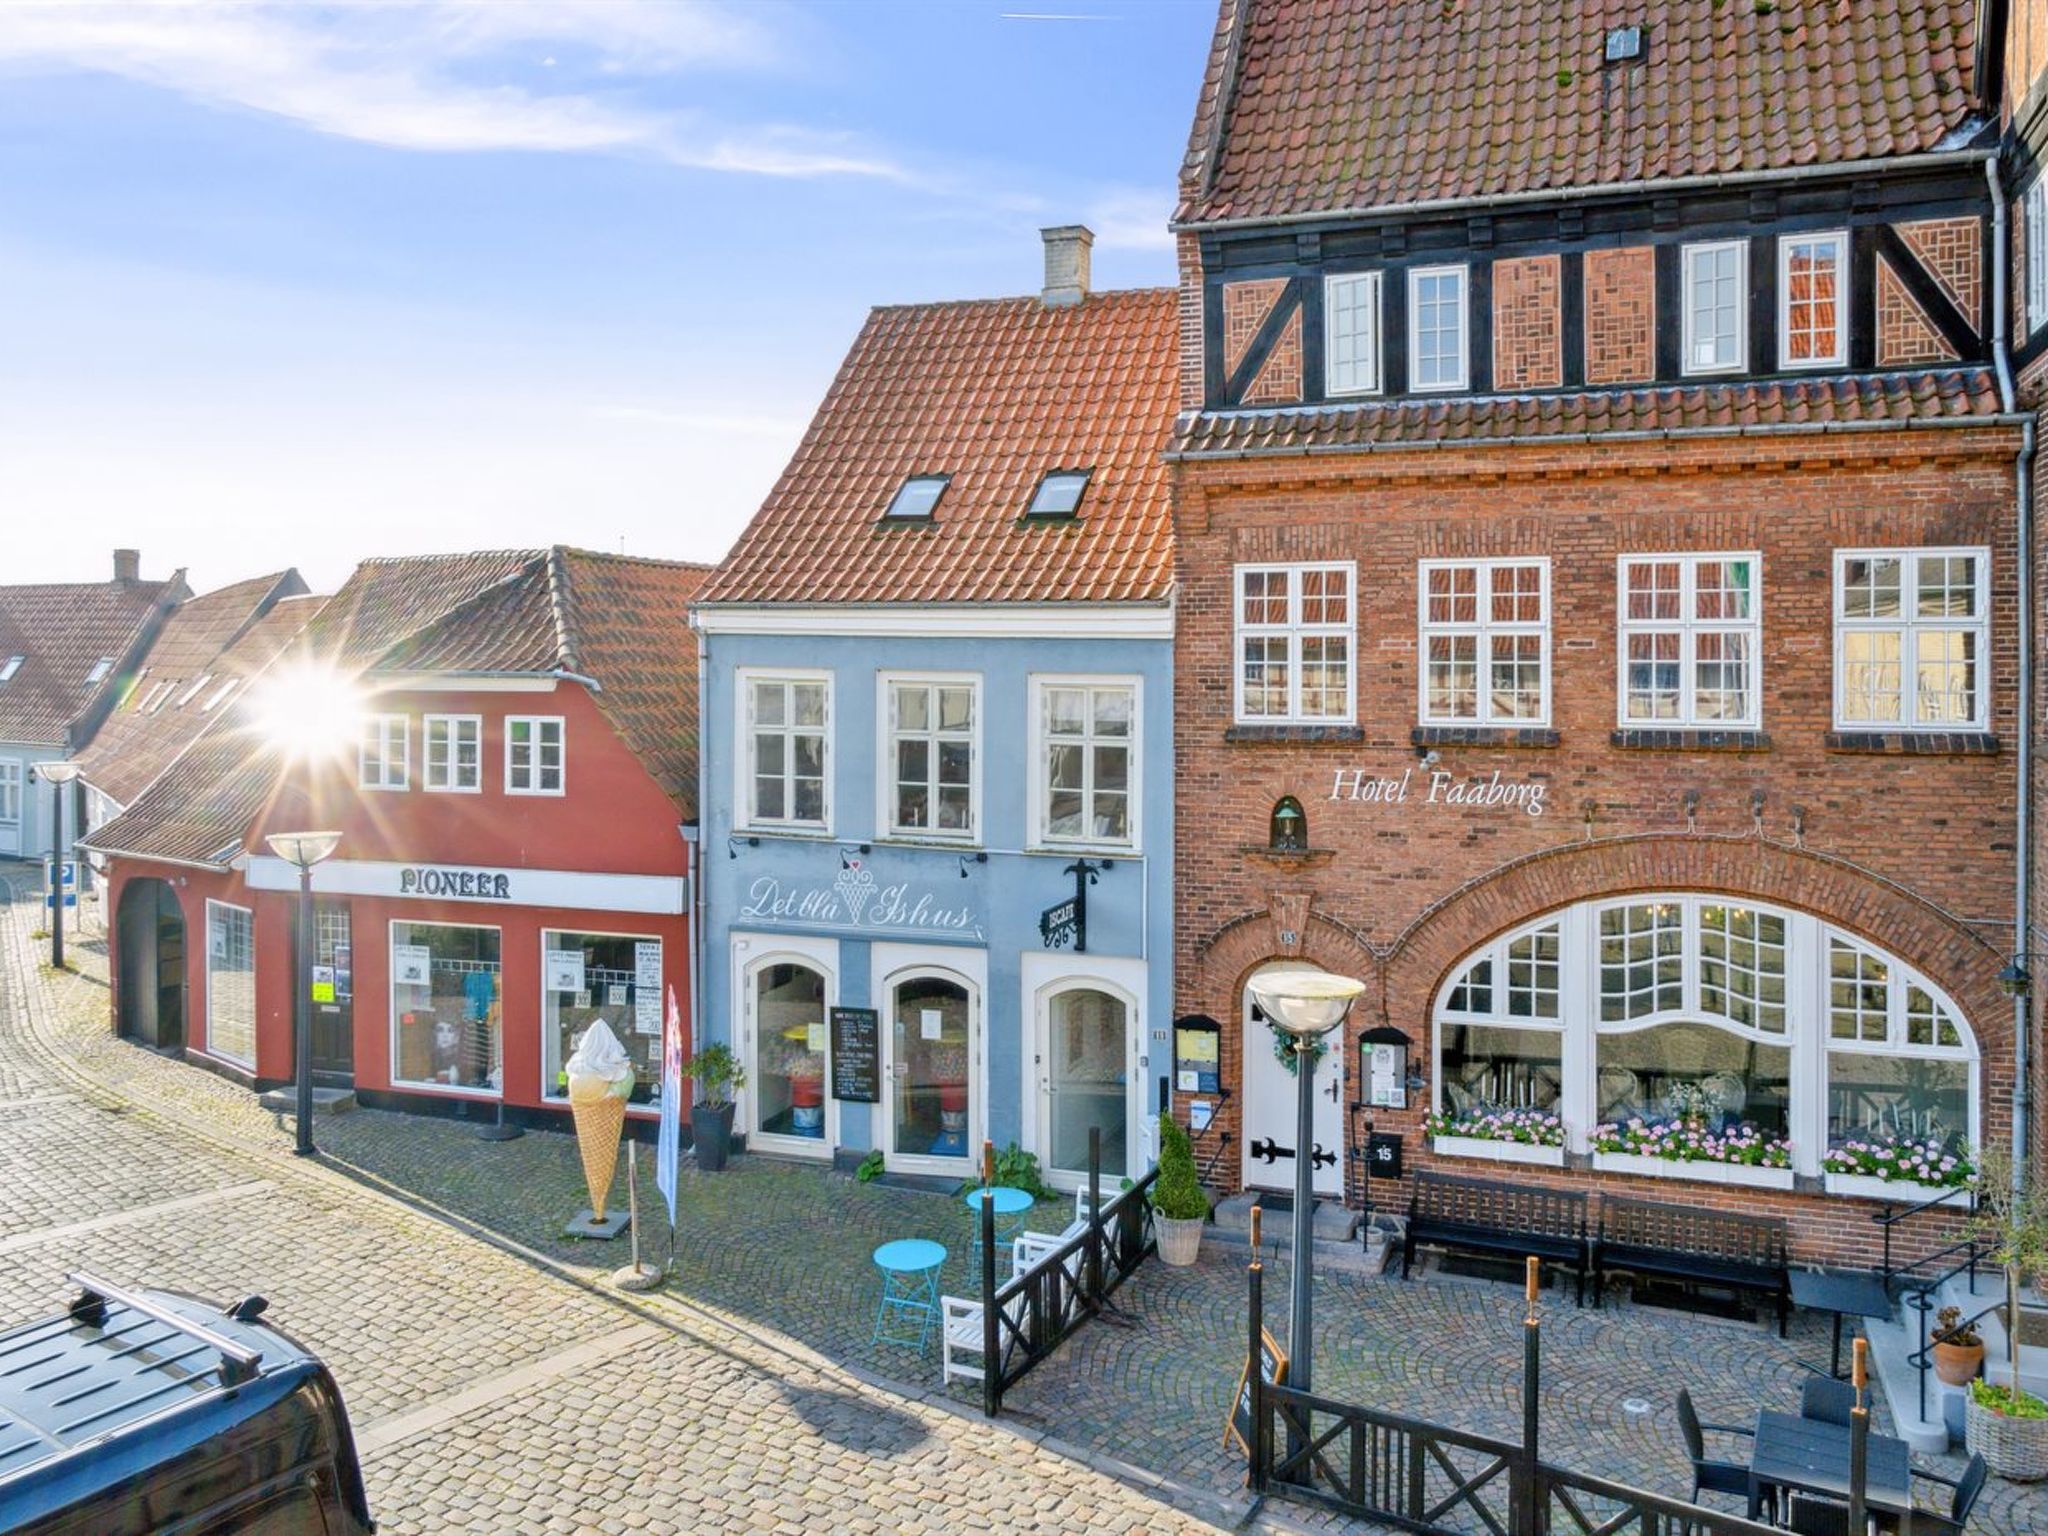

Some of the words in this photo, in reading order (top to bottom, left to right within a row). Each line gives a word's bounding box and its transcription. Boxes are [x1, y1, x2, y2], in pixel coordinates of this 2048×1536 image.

[1328, 768, 1412, 802] Hotel
[1425, 770, 1545, 816] Faaborg
[400, 868, 511, 899] PIONEER
[740, 876, 797, 919] Det
[869, 883, 977, 928] Ishus
[1376, 1148, 1392, 1161] 15
